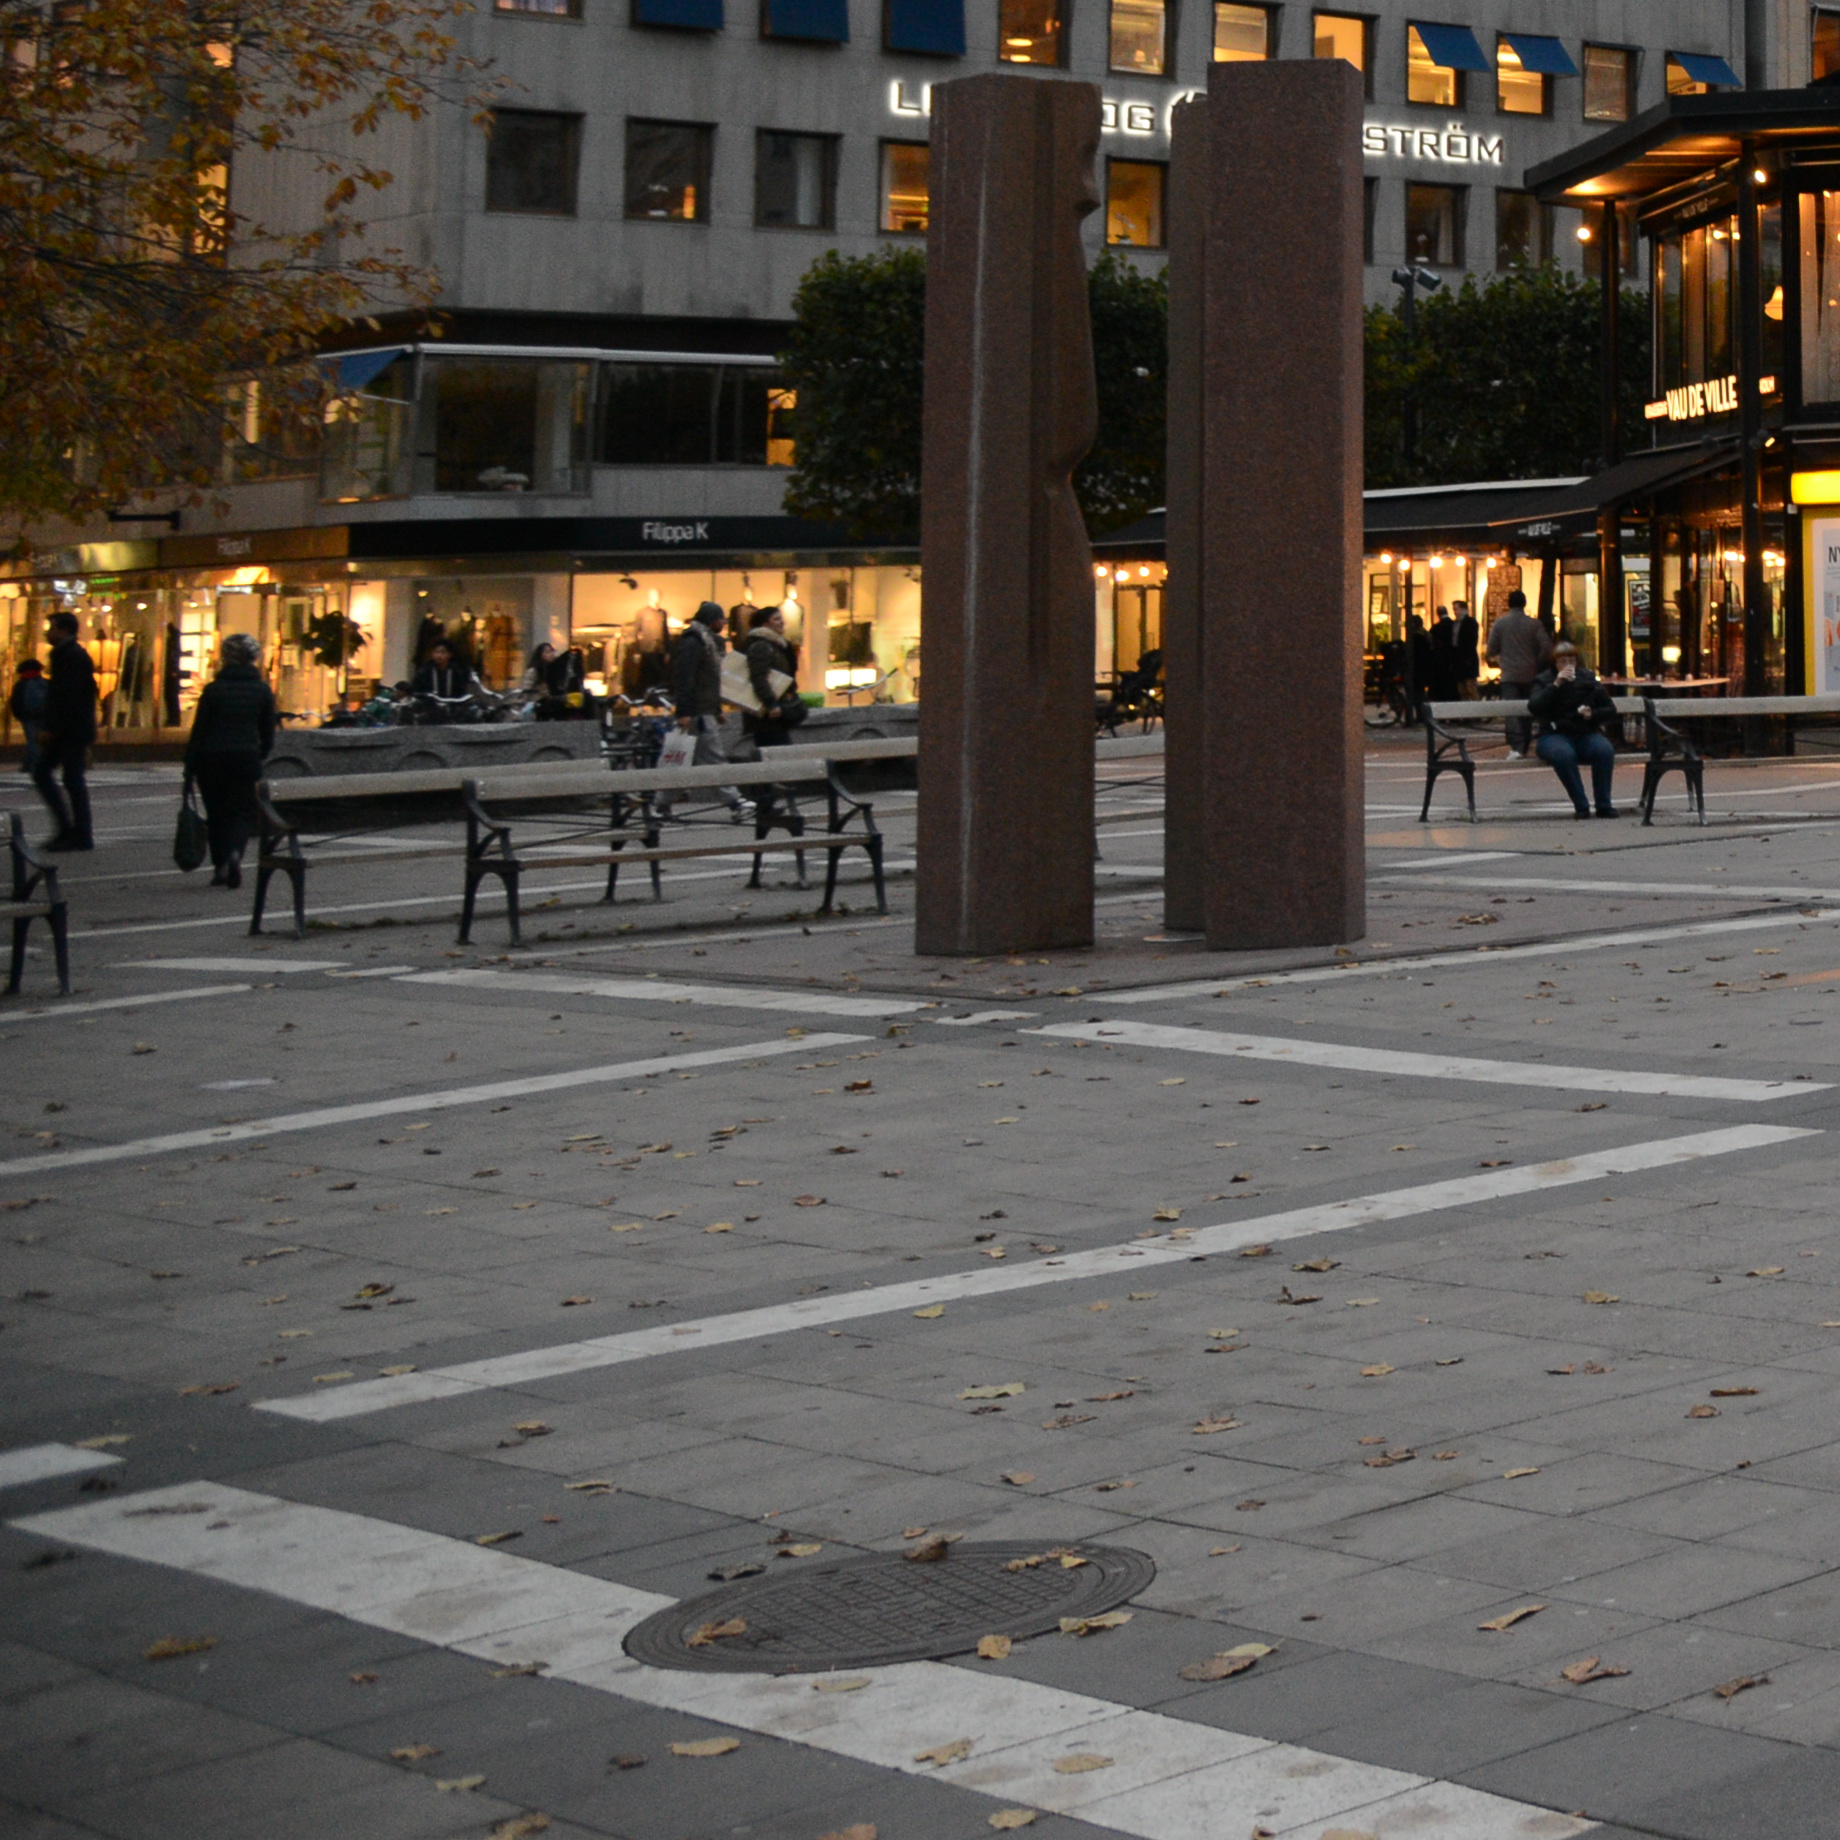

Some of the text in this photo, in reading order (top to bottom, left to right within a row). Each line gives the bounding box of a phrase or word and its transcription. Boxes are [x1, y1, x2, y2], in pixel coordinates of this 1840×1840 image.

[1362, 120, 1505, 164] STRÖM
[1666, 387, 1688, 421] VAU
[1688, 383, 1705, 418] DE
[1704, 375, 1738, 413] VILLE
[642, 521, 709, 544] Filippa K
